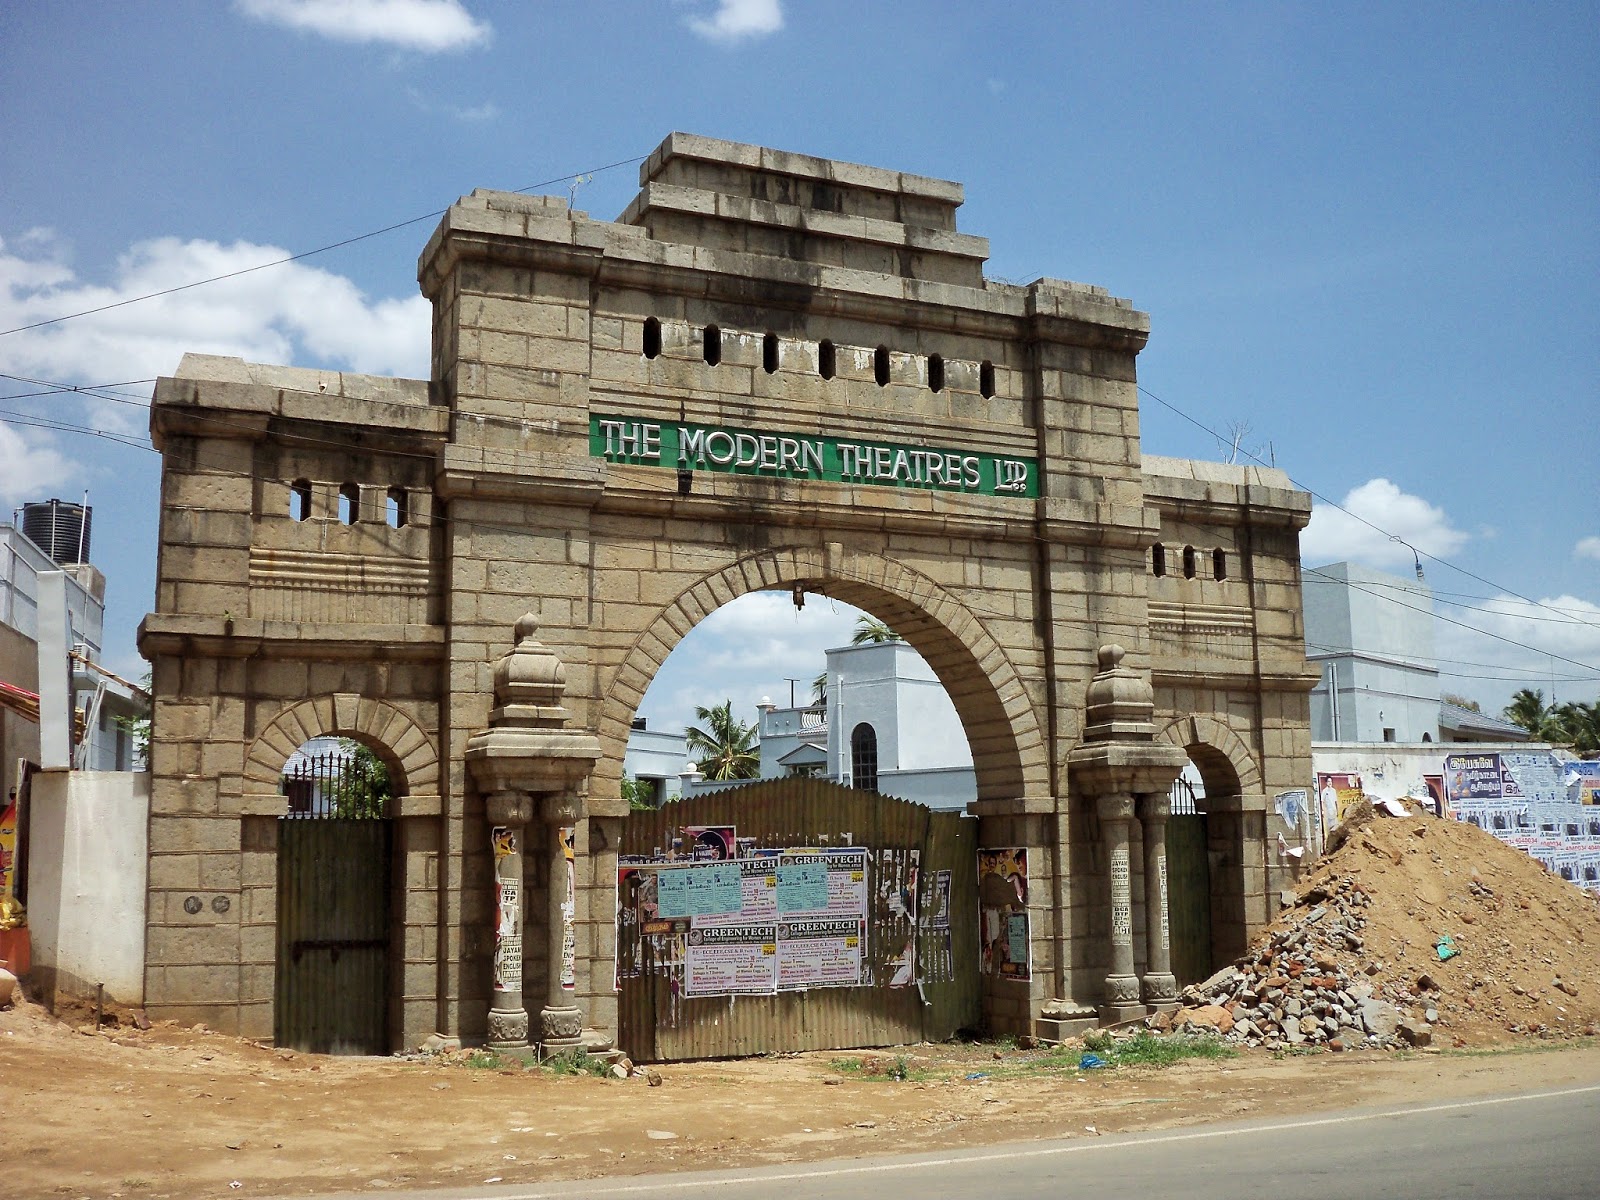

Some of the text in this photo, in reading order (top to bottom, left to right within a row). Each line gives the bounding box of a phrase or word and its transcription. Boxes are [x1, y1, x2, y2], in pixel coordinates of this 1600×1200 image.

[600, 420, 660, 457] THE
[678, 427, 824, 473] MODERN
[837, 443, 980, 487] THEATRES
[790, 921, 856, 931] GREENTECH
[703, 928, 773, 936] GREENTECH
